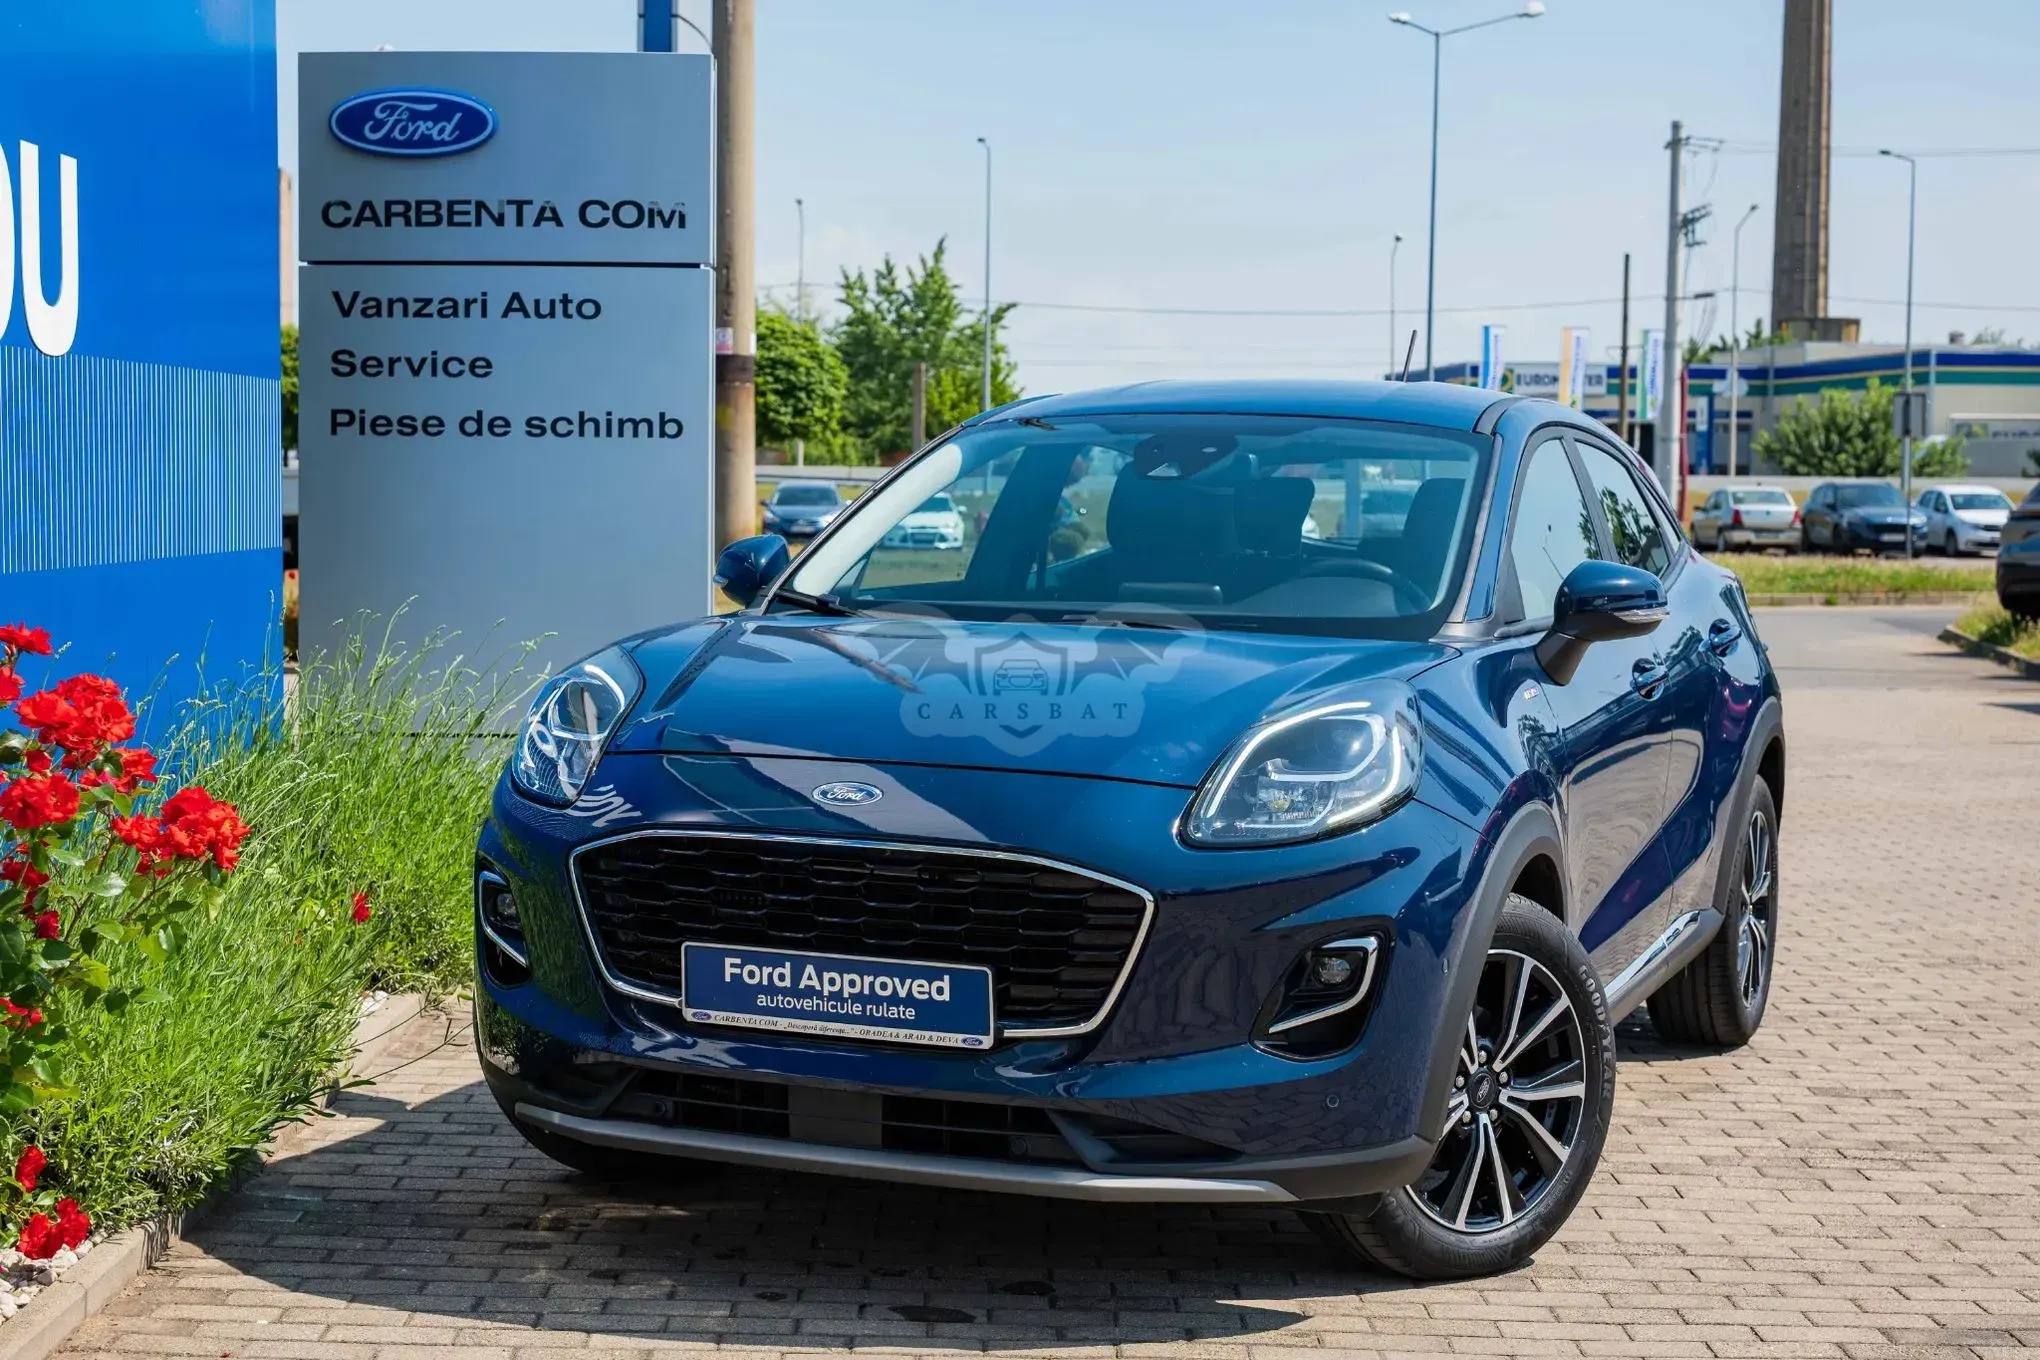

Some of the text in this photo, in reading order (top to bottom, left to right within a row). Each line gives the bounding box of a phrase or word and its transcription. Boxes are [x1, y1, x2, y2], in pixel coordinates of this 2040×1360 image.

[363, 100, 462, 142] Ford
[321, 199, 687, 230] CARBENTA COM
[0, 139, 79, 357] U
[331, 290, 602, 320] Vanzari Auto
[330, 349, 493, 378] Service
[330, 408, 684, 440] Piese de schimb
[724, 957, 950, 1001] Ford Approved
[757, 993, 916, 1020] autovehicule rulate
[714, 1014, 757, 1026] CARBENTA
[759, 1018, 778, 1028] COM
[859, 1028, 893, 1039] ORADEA
[902, 1032, 926, 1041] ARAD
